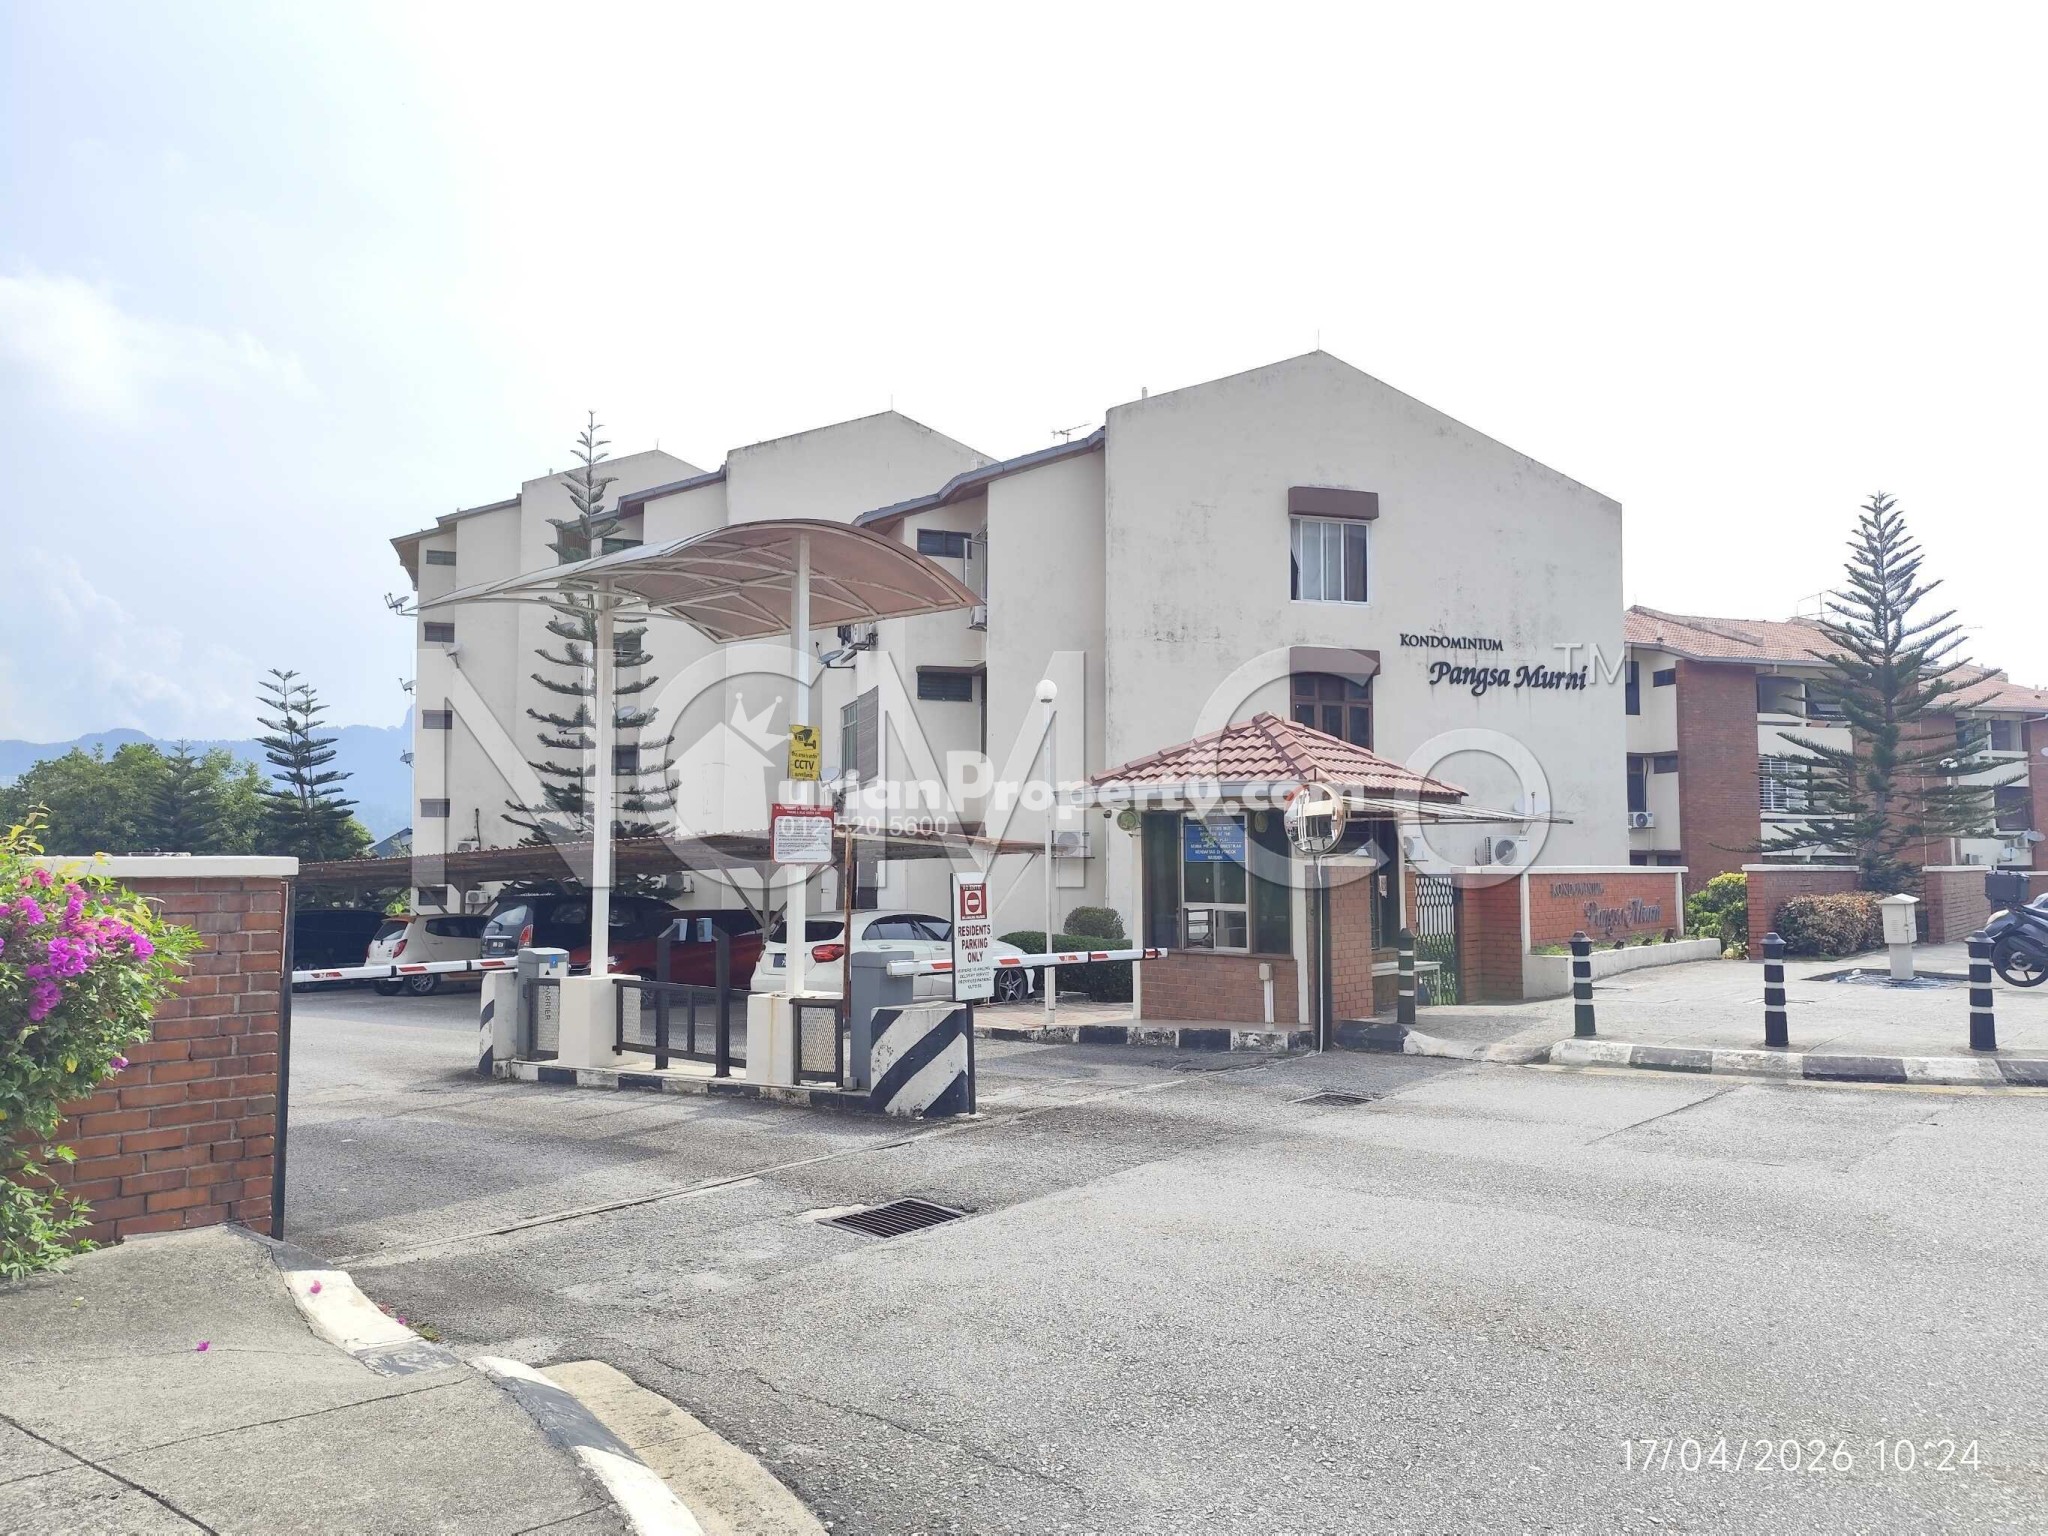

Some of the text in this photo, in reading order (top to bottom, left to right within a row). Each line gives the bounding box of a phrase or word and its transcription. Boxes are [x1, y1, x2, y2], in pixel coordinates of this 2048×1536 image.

[1400, 633, 1504, 651] KONDOMINIUM
[1429, 661, 1589, 696] Pangsa Murni
[794, 759, 815, 770] CCTV
[957, 924, 991, 937] RESIDENTS
[961, 938, 988, 950] PARKING
[967, 951, 983, 963] ONLY
[543, 984, 552, 1021] ARRIER
